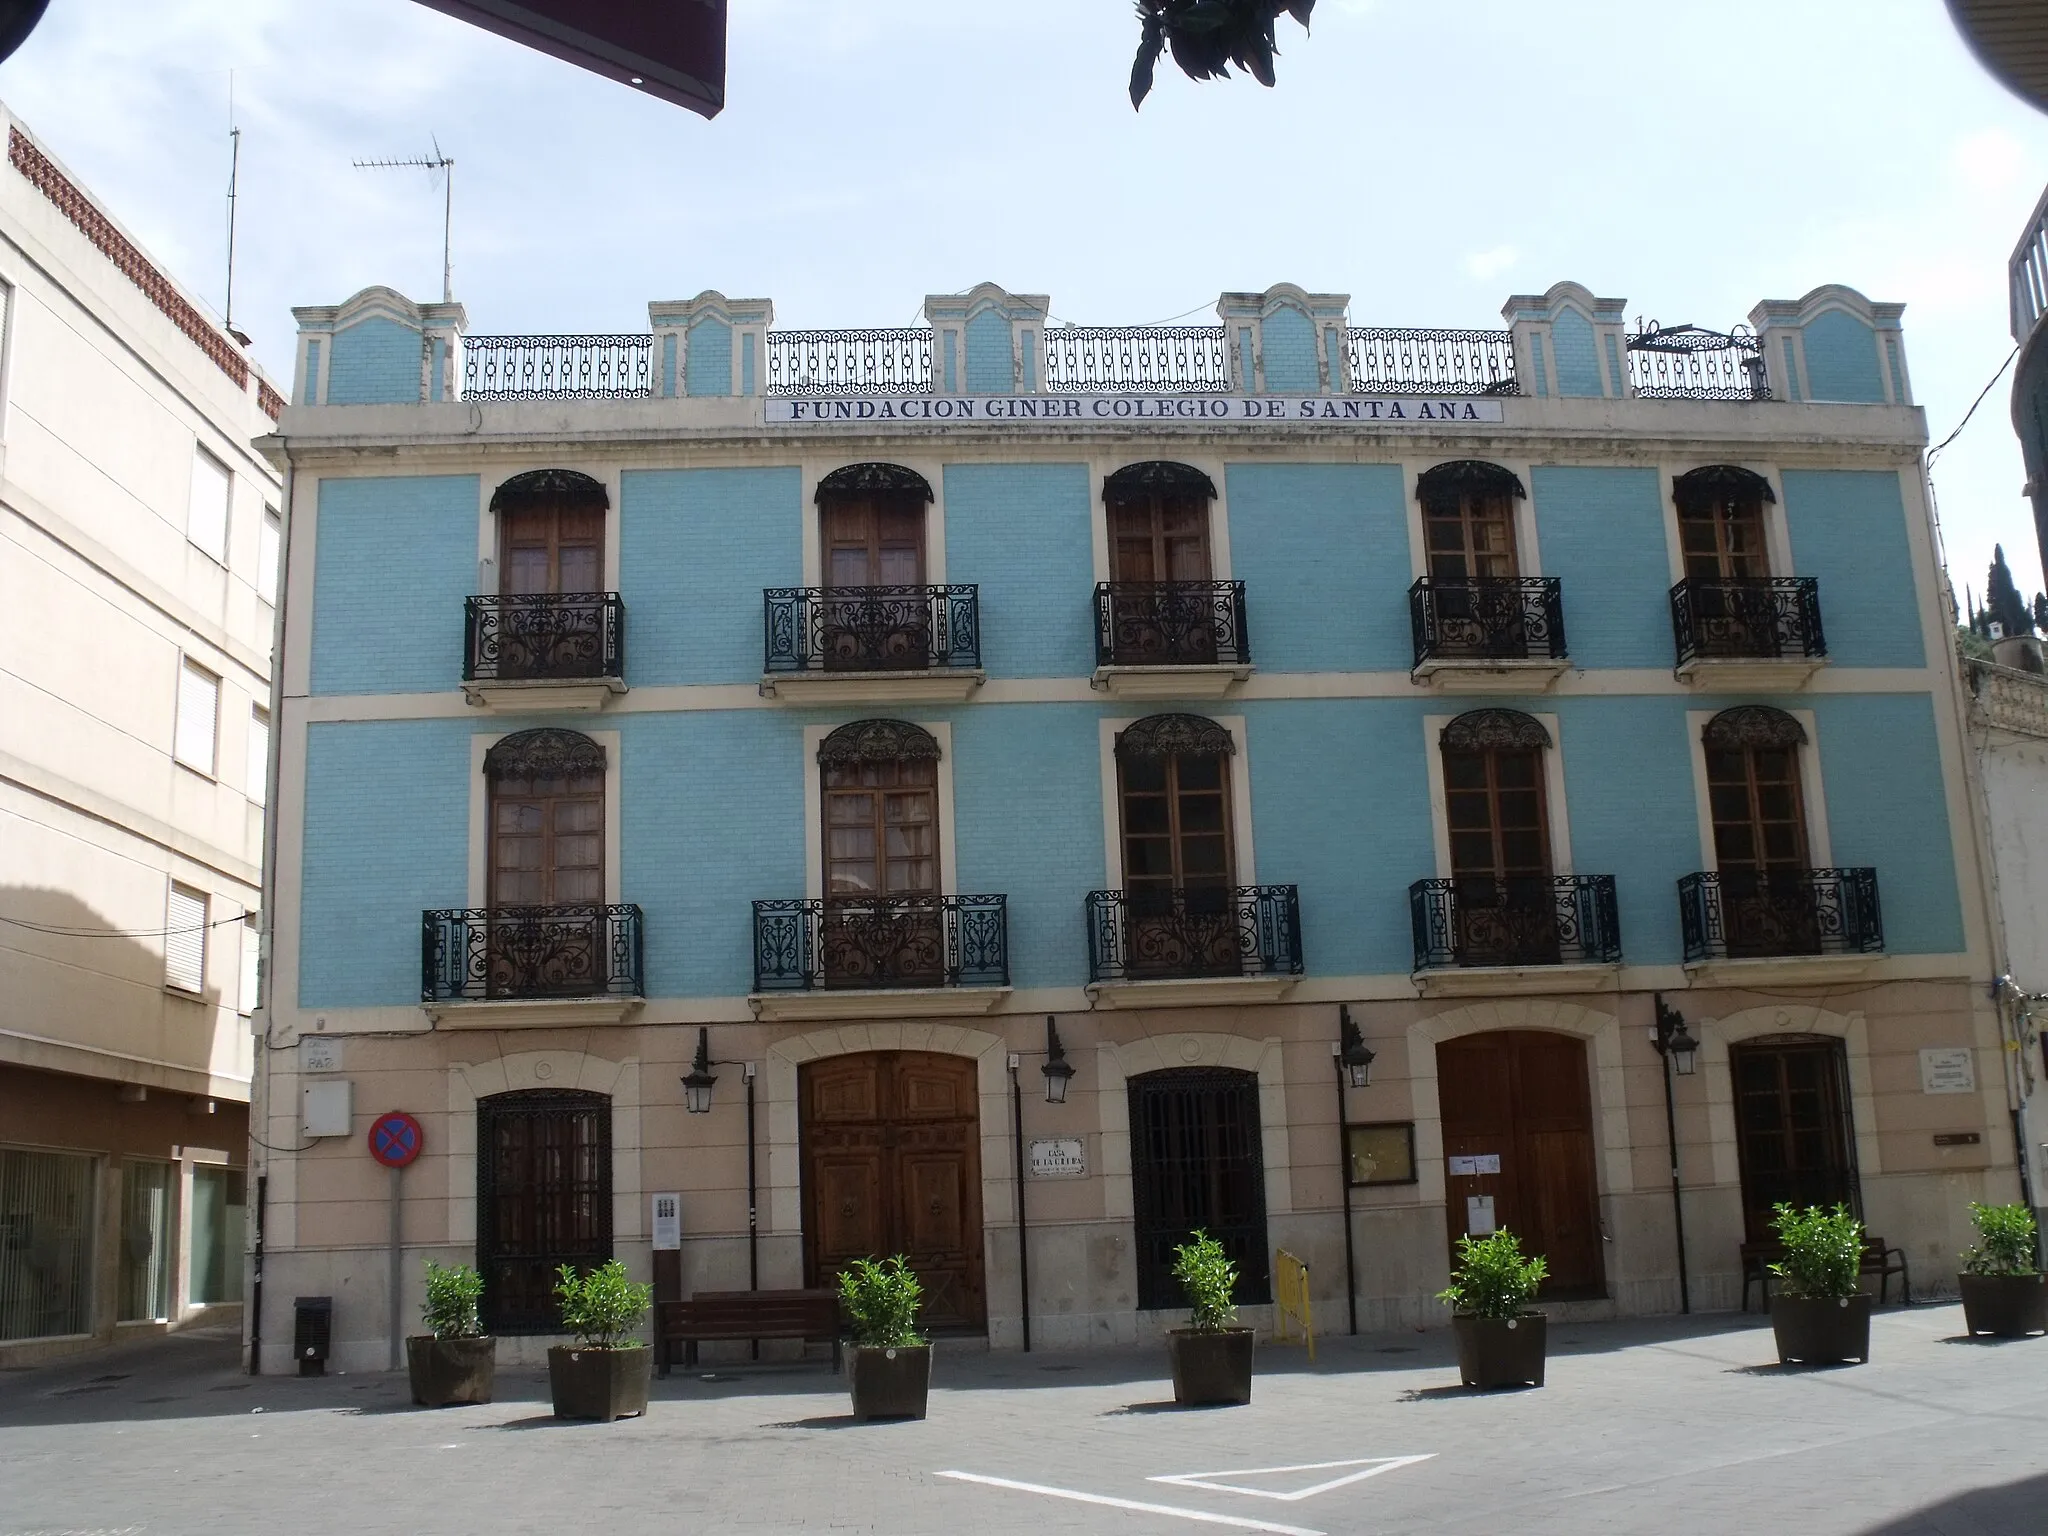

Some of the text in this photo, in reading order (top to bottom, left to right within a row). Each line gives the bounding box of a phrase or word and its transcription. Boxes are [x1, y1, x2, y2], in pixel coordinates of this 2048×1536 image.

[790, 399, 1480, 420] FUNDACION GINER COLEGIO DE SANTA ANA
